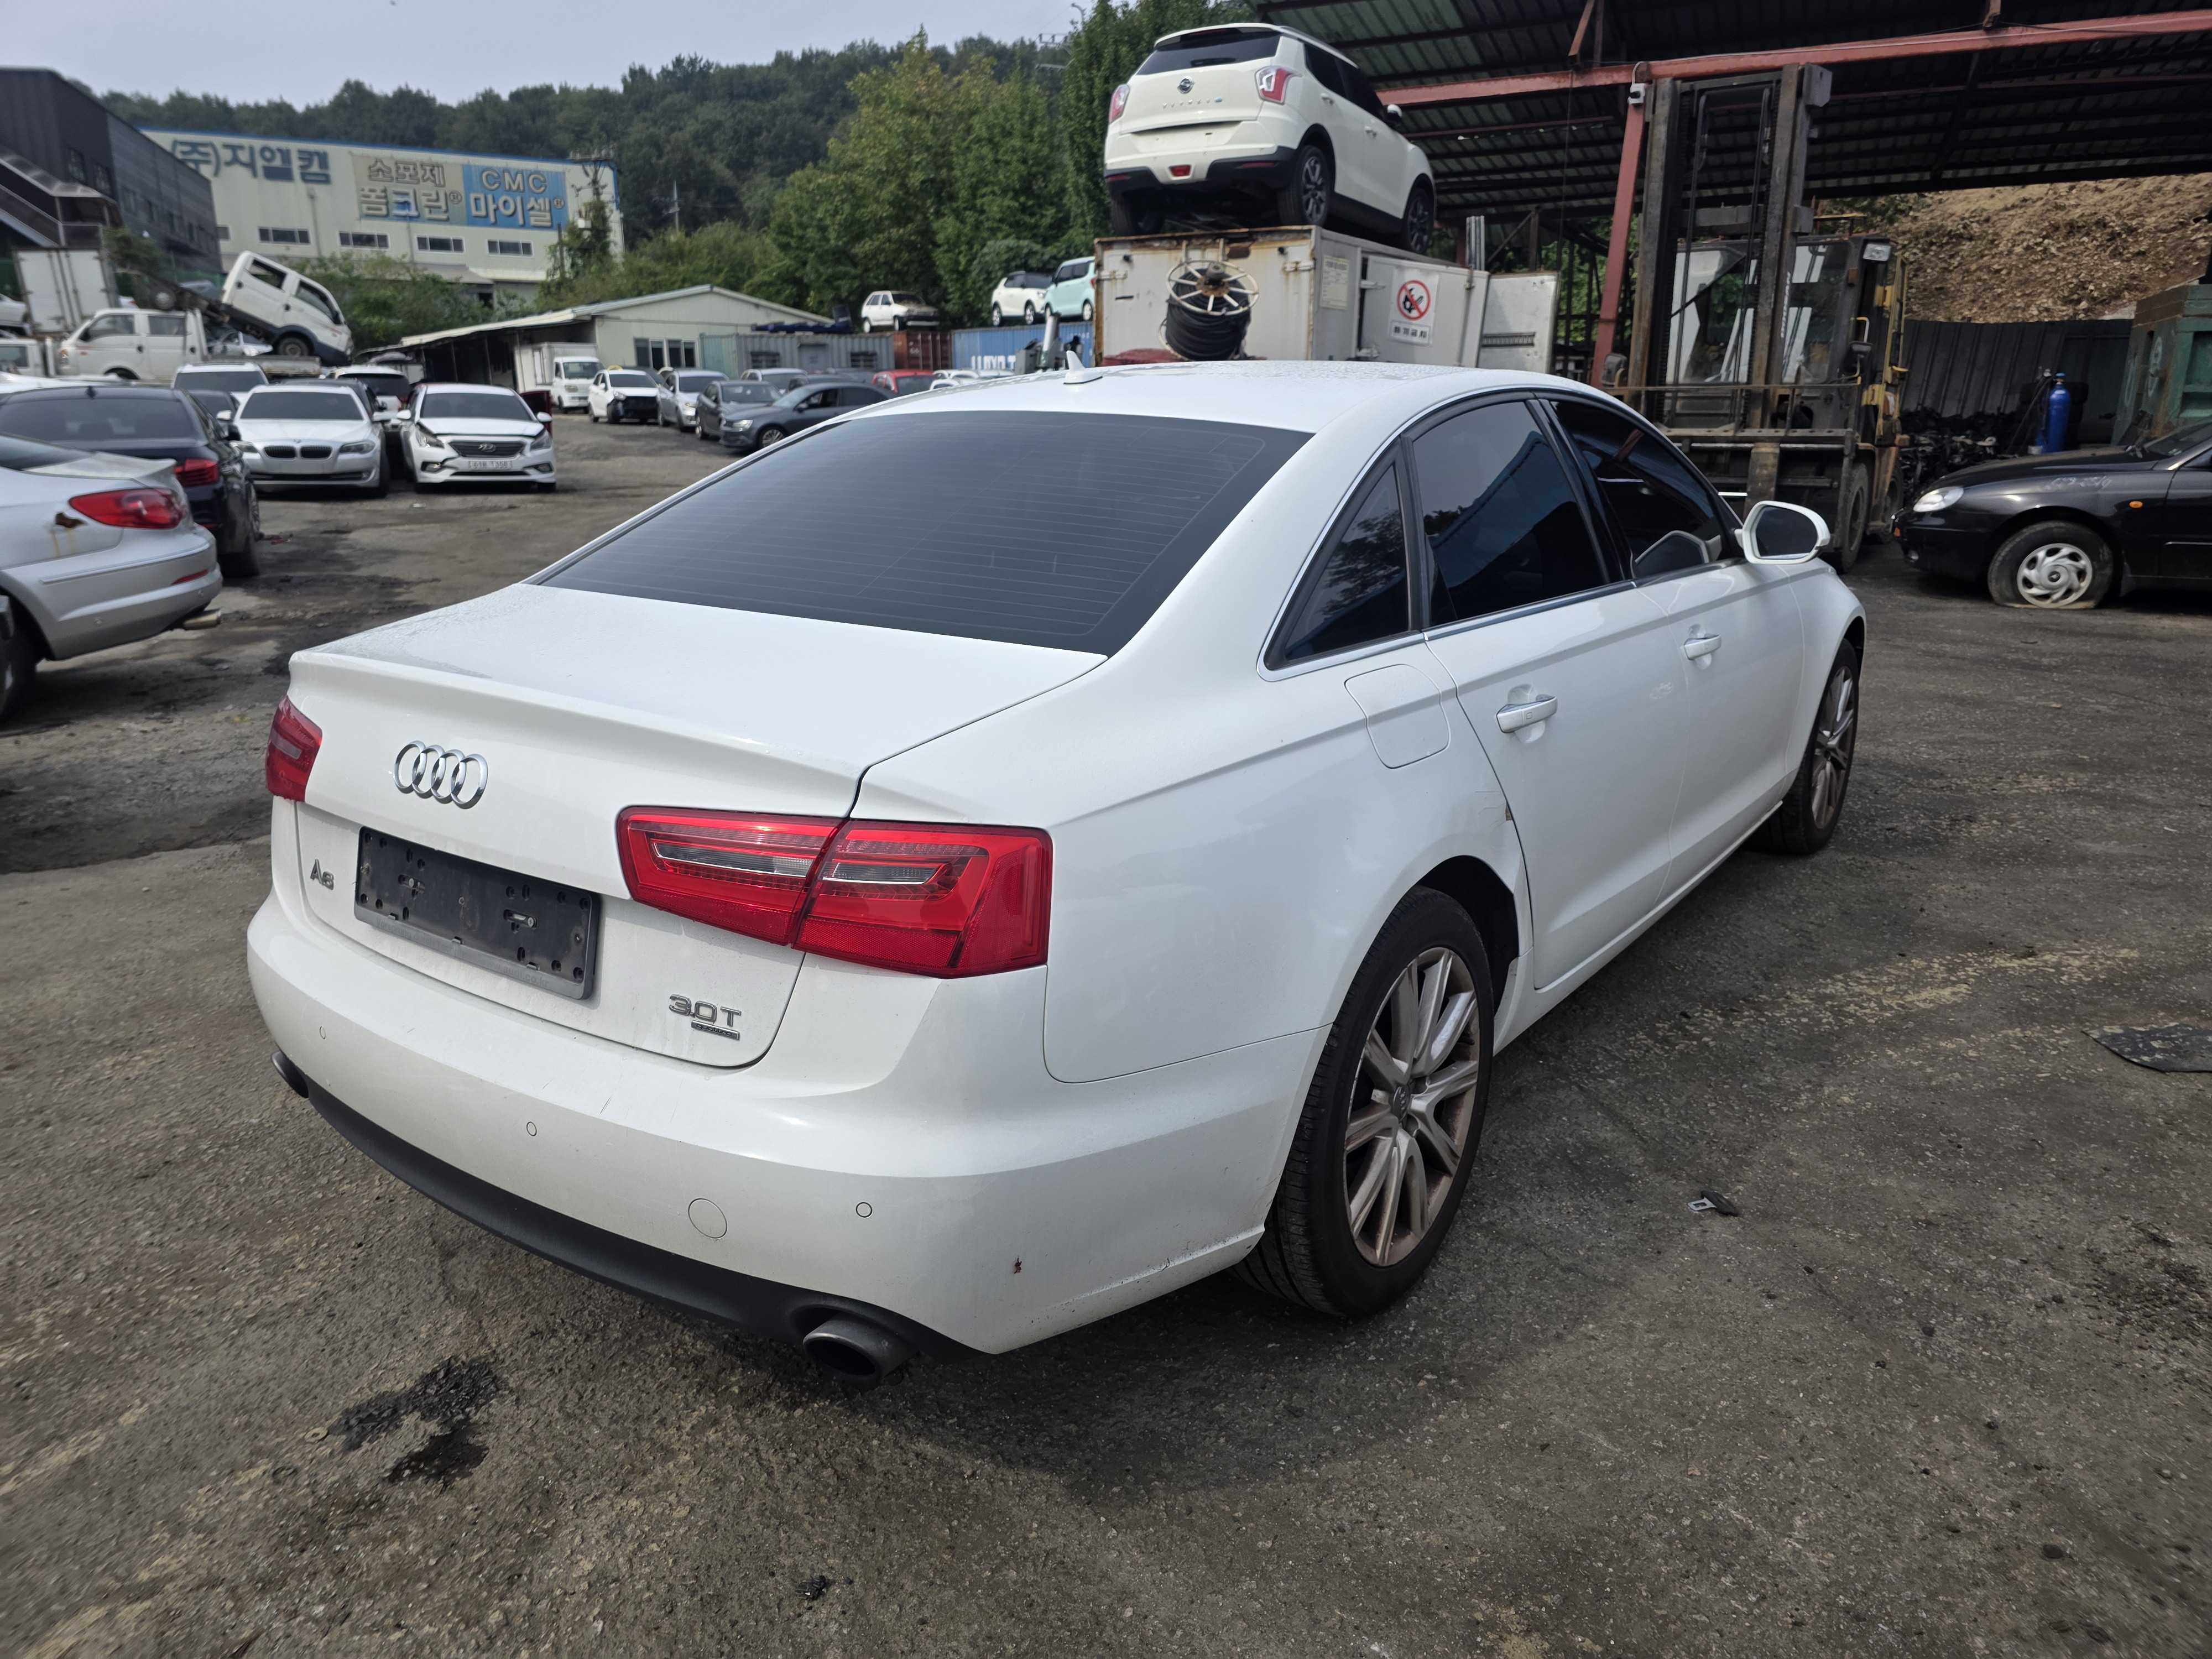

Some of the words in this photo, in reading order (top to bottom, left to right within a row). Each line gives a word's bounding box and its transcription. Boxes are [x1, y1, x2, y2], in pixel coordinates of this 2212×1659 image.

[368, 158, 446, 187] 소포제
[481, 168, 547, 194] CMC
[310, 858, 334, 890] A6
[669, 994, 742, 1027] 3.0T
[696, 1024, 732, 1036] quattro
